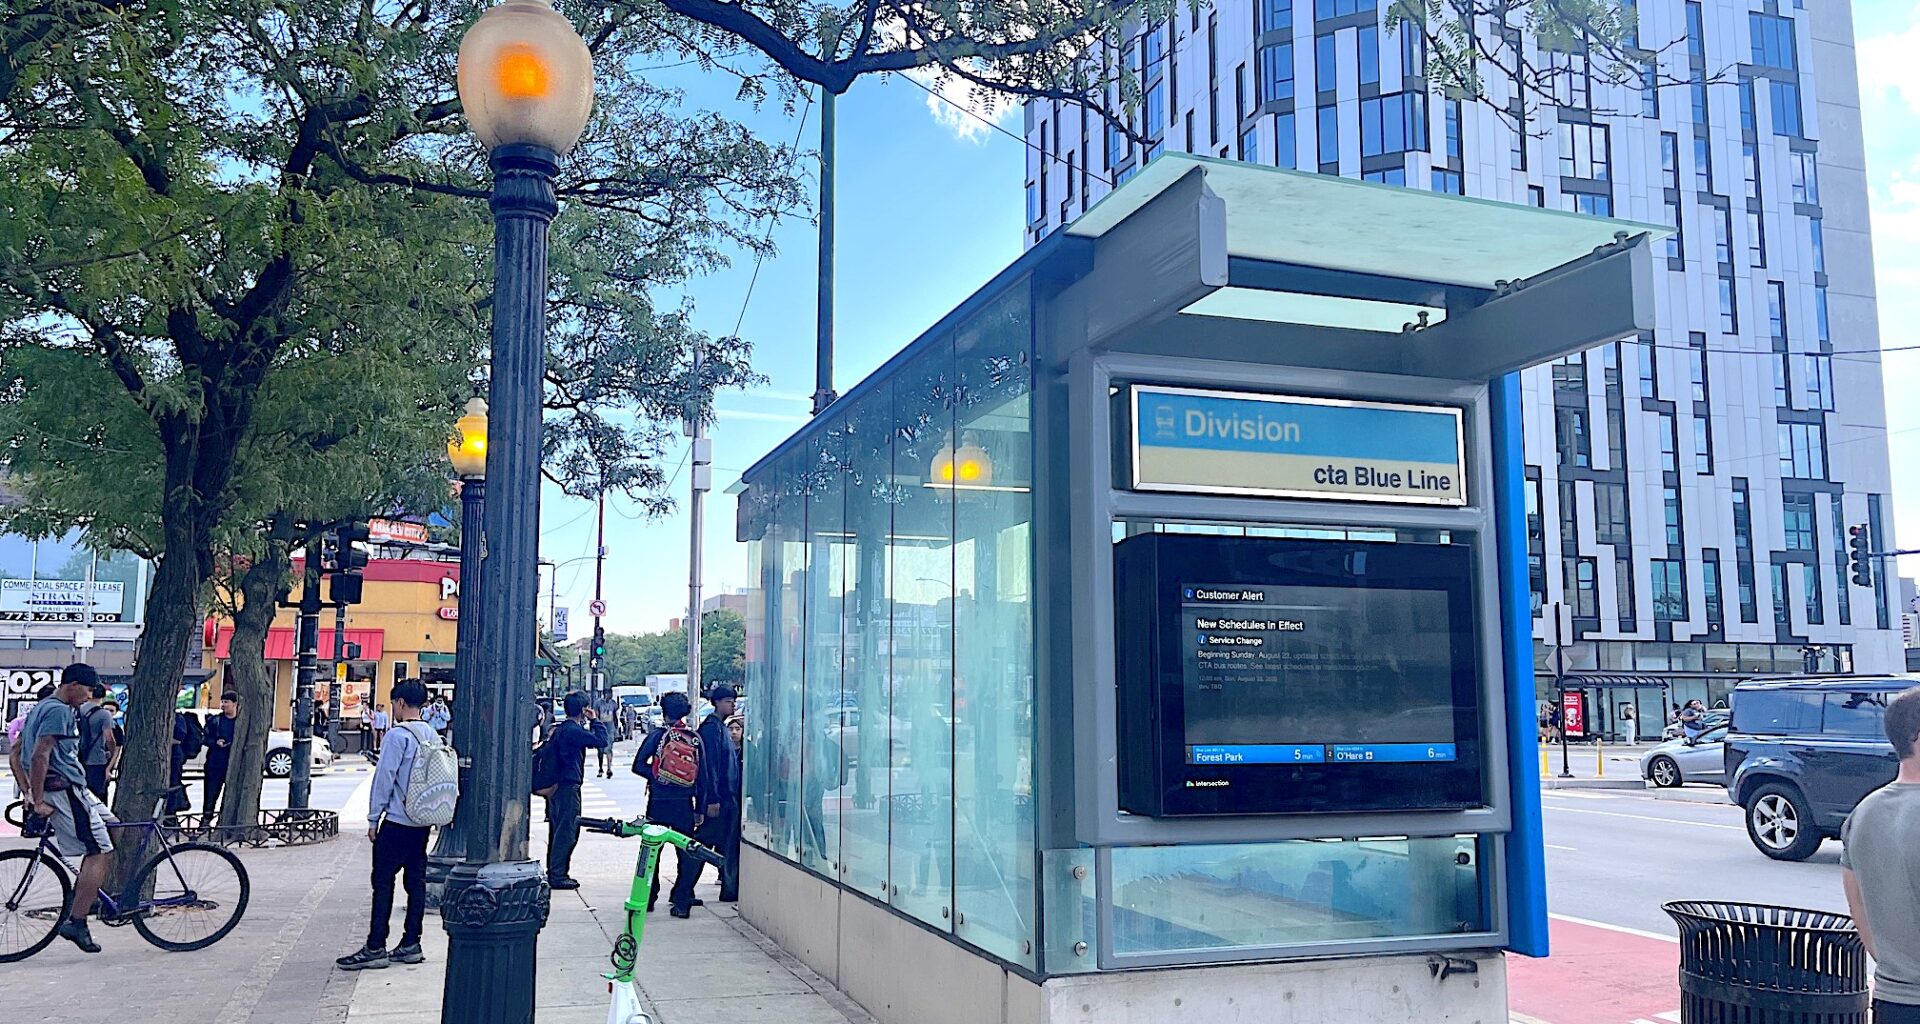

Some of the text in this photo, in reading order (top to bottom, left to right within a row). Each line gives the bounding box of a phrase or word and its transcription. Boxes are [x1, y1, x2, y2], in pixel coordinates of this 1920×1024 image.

[1185, 410, 1299, 443] Division
[1314, 464, 1450, 491] cta Blue Line
[3, 580, 122, 592] COMMERCIAL SPACE FR LEASE
[32, 592, 94, 600] STRAUS
[1196, 589, 1264, 601] Customer Alert
[4, 612, 117, 622] 773.736.300
[1197, 619, 1217, 629] New
[1218, 619, 1266, 630] Schedules
[1278, 621, 1304, 631] Effect
[1209, 637, 1263, 647] Service Change
[1197, 650, 1230, 660] Beginning
[1258, 652, 1281, 660] August
[1196, 753, 1244, 762] Forest Park
[1294, 749, 1301, 760] 5
[1337, 752, 1364, 760] O'Hare
[1428, 748, 1435, 758] 6
